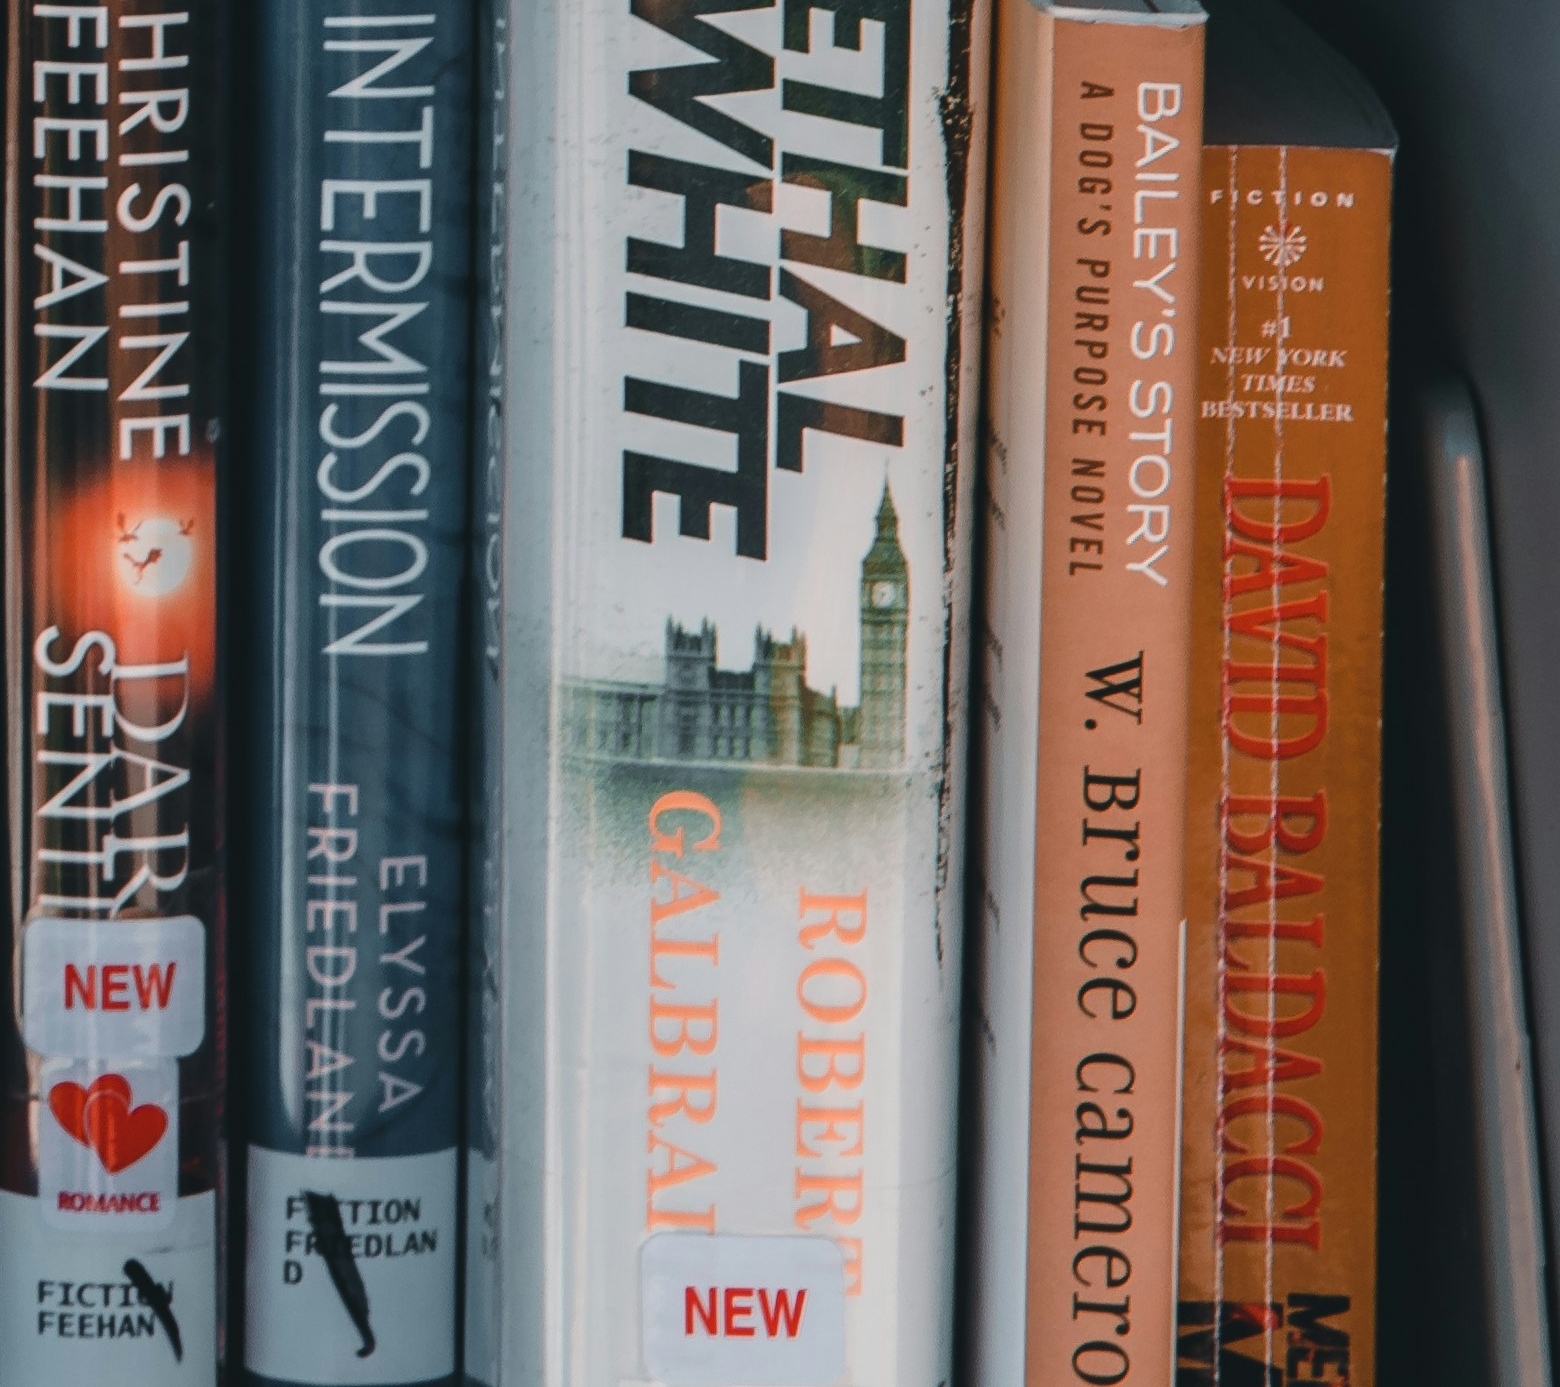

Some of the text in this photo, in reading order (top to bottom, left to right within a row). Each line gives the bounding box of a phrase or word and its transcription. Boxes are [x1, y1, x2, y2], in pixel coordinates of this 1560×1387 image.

[32, 4, 108, 391] FEEHAN
[1210, 189, 1355, 208] FICTION
[1243, 275, 1325, 293] VISION
[316, 12, 436, 656] INTERMISSION
[1068, 79, 1112, 579] A DOG'S PURPOSE NOVEL
[1124, 79, 1183, 589] BAILEY'S STORY
[1261, 318, 1290, 339] #1
[1210, 347, 1347, 367] NEW YORK
[1241, 374, 1315, 393] TIMES
[1201, 401, 1353, 422] BESTSELLER
[62, 962, 177, 1011] NEW
[58, 1191, 160, 1214] ROMANCE
[36, 1310, 155, 1339] FEEHAN
[684, 1286, 808, 1339] NEW
